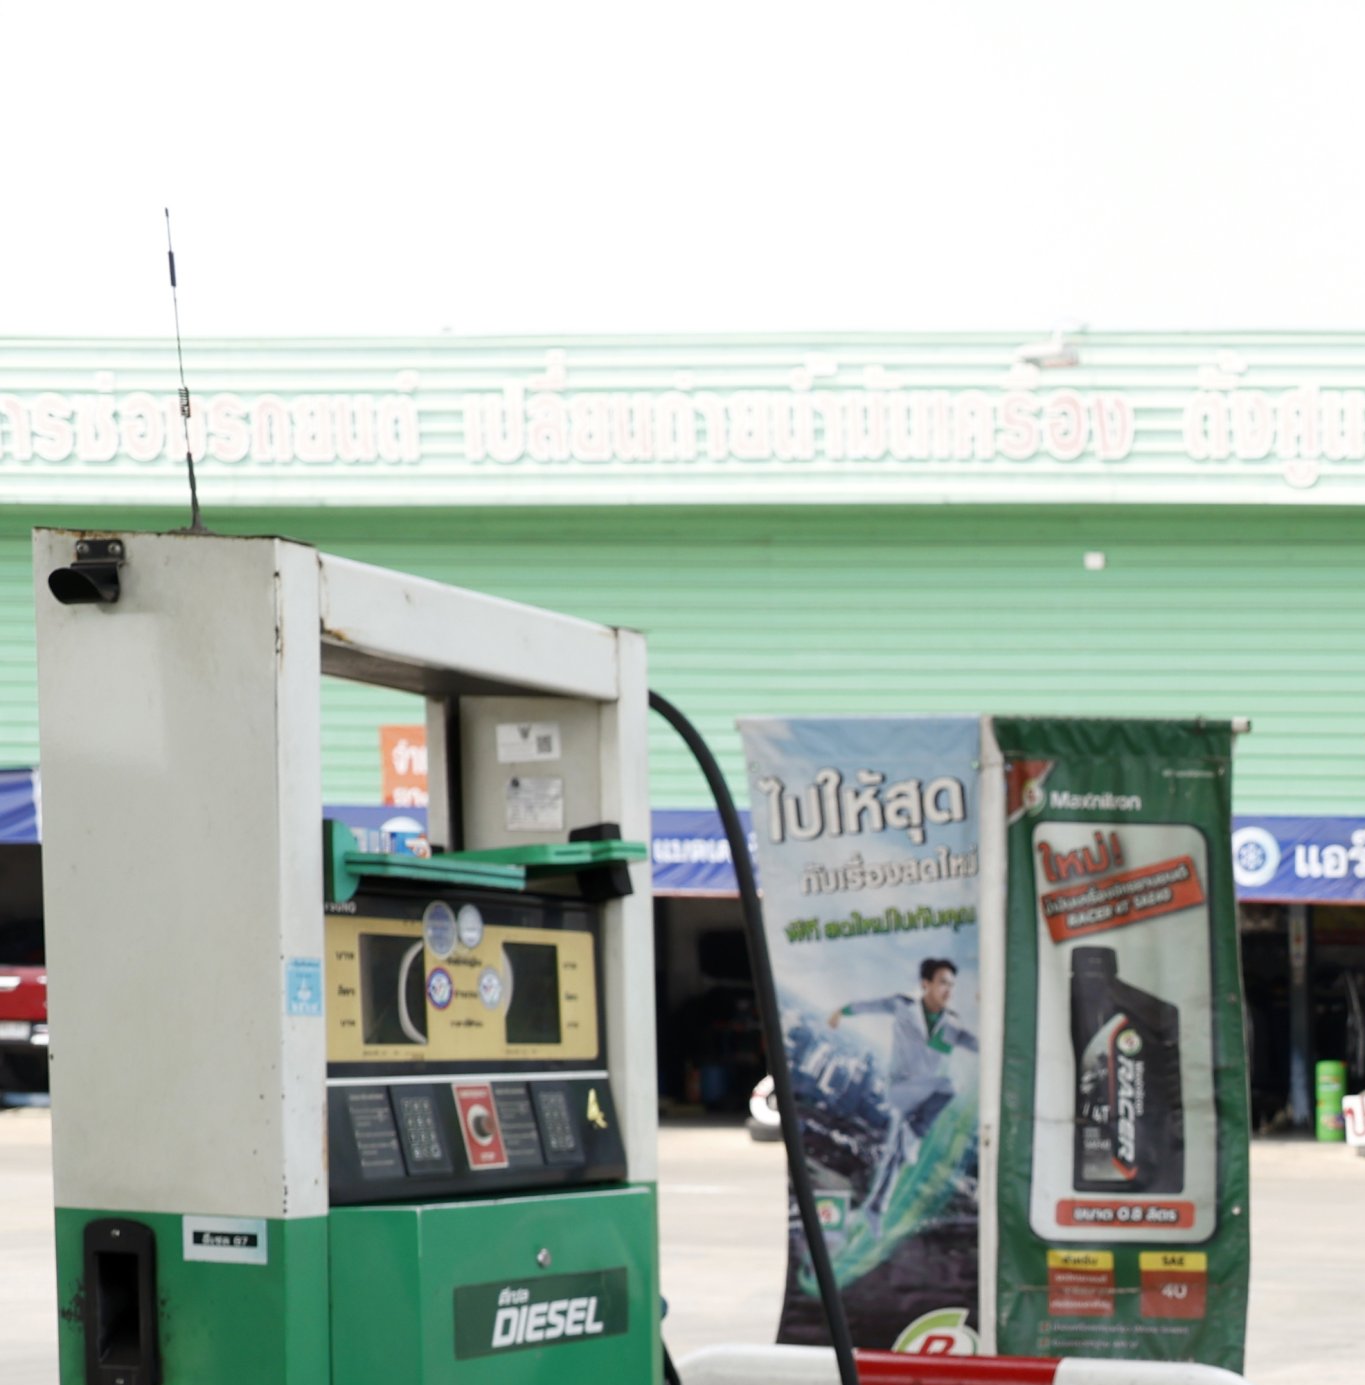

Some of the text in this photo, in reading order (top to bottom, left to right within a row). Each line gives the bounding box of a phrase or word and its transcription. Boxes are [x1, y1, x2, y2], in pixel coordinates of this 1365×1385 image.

[0, 369, 420, 465] ารซ่อมรถยนต์
[757, 766, 967, 845] ไปให้สุด
[1038, 830, 1124, 883] ใหม่!
[491, 1295, 605, 1349] DIESEL
